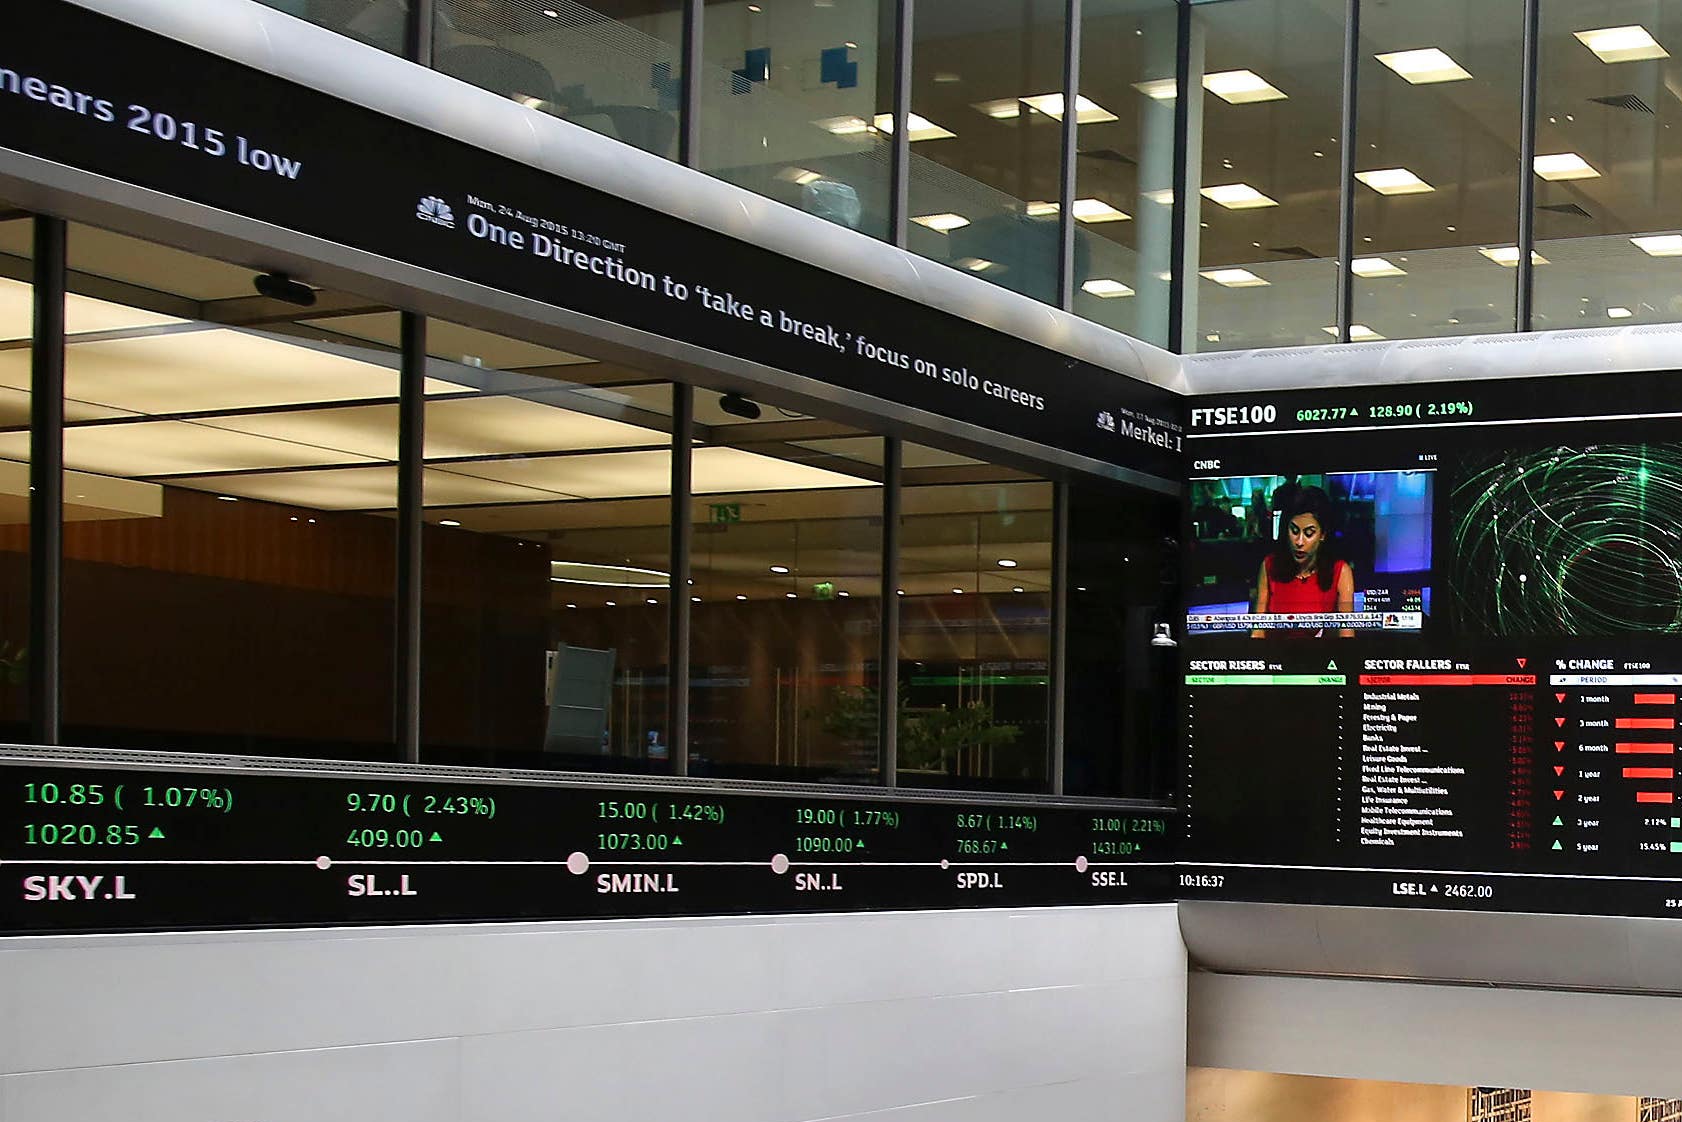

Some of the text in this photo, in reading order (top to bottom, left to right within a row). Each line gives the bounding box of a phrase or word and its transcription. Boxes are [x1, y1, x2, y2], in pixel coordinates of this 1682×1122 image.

[0, 67, 301, 181] nears 2015 low
[515, 210, 539, 228] Aug
[540, 218, 569, 236] 2015
[602, 239, 627, 253] GMT
[466, 213, 525, 251] One
[531, 232, 657, 292] Direction
[662, 275, 689, 301] to
[759, 307, 775, 329] a
[855, 334, 910, 370] focus
[914, 357, 938, 379] on
[941, 363, 980, 391] solo
[982, 378, 1045, 411] careers
[1191, 405, 1277, 427] FTSE100
[1296, 408, 1347, 421] 6027.77
[1369, 404, 1413, 418] 128.90
[1121, 419, 1173, 449] Merkel:
[1194, 460, 1221, 470] CNBC
[1190, 660, 1266, 670] SECTOR RISERS
[1364, 659, 1452, 670] SECTOR FALLERS
[1568, 659, 1614, 670] CHANGE
[1585, 744, 1608, 752] month
[1584, 771, 1601, 780] year
[23, 783, 105, 805] 10.85
[346, 794, 396, 813] 9.70
[598, 802, 646, 819] 15.00
[796, 809, 836, 825] 19.00
[956, 814, 983, 829] 8.67
[1092, 818, 1121, 831] 31.00
[23, 823, 140, 846] 1020.85
[346, 829, 423, 849] 409.00
[598, 833, 668, 850] 1073.00
[796, 837, 853, 852] 1090.00
[956, 839, 998, 854] 768.67
[347, 875, 418, 897] SL..L
[597, 873, 679, 893] SMIN.L
[795, 873, 843, 891] SN..L
[956, 872, 1003, 888] SPD.L
[1091, 872, 1128, 887] SSE.L
[1179, 875, 1224, 887] 10:16:37
[23, 875, 137, 901] SKY.L
[1392, 882, 1493, 898] LSE.L 2462.00
